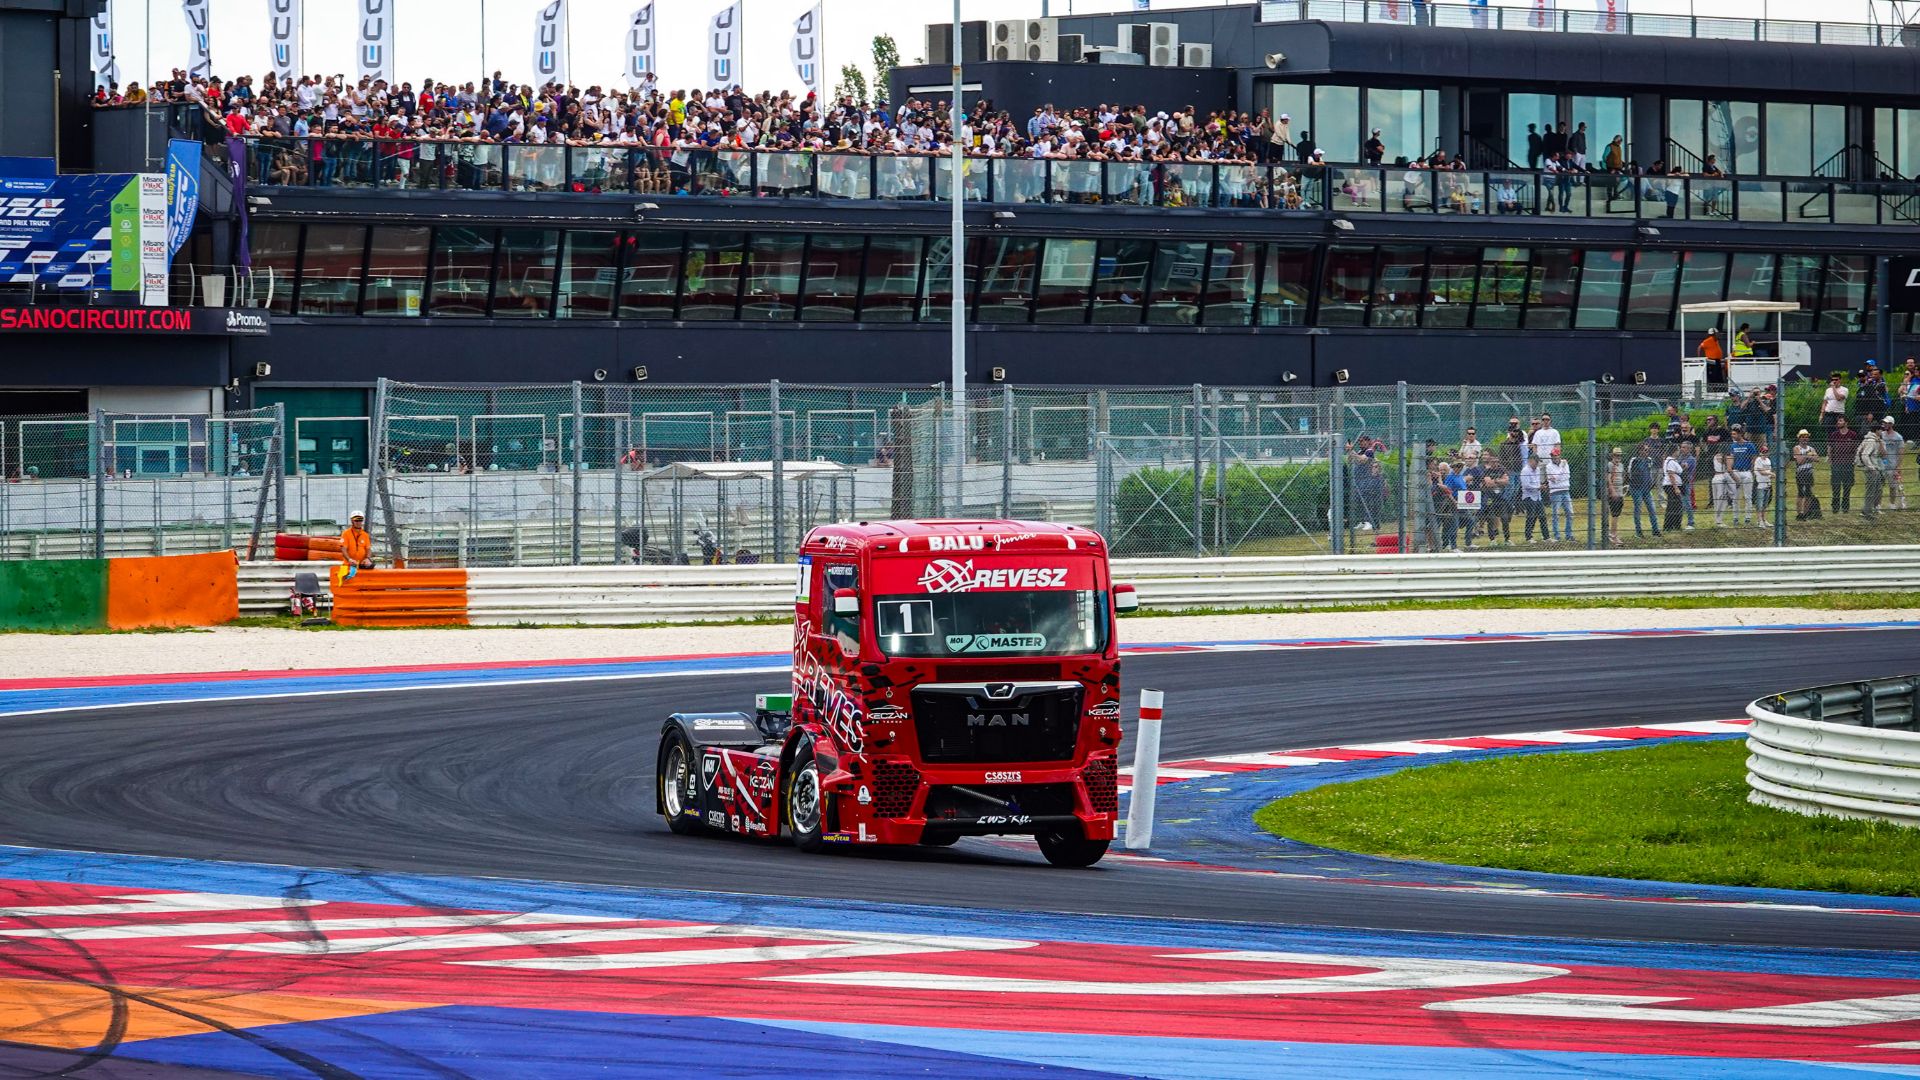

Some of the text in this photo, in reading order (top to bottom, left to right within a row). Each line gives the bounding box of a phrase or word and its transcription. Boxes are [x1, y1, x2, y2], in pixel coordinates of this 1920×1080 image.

[167, 163, 176, 205] GOODYEAR
[1, 308, 191, 330] SANOCIRCUIT.COM
[236, 312, 262, 326] Promo
[928, 536, 984, 551] BALU
[994, 533, 1037, 552] Junior
[899, 604, 913, 634] 1
[991, 637, 1042, 648] MASTER
[967, 714, 1029, 726] MAN
[823, 834, 850, 842] GOODYEAR
